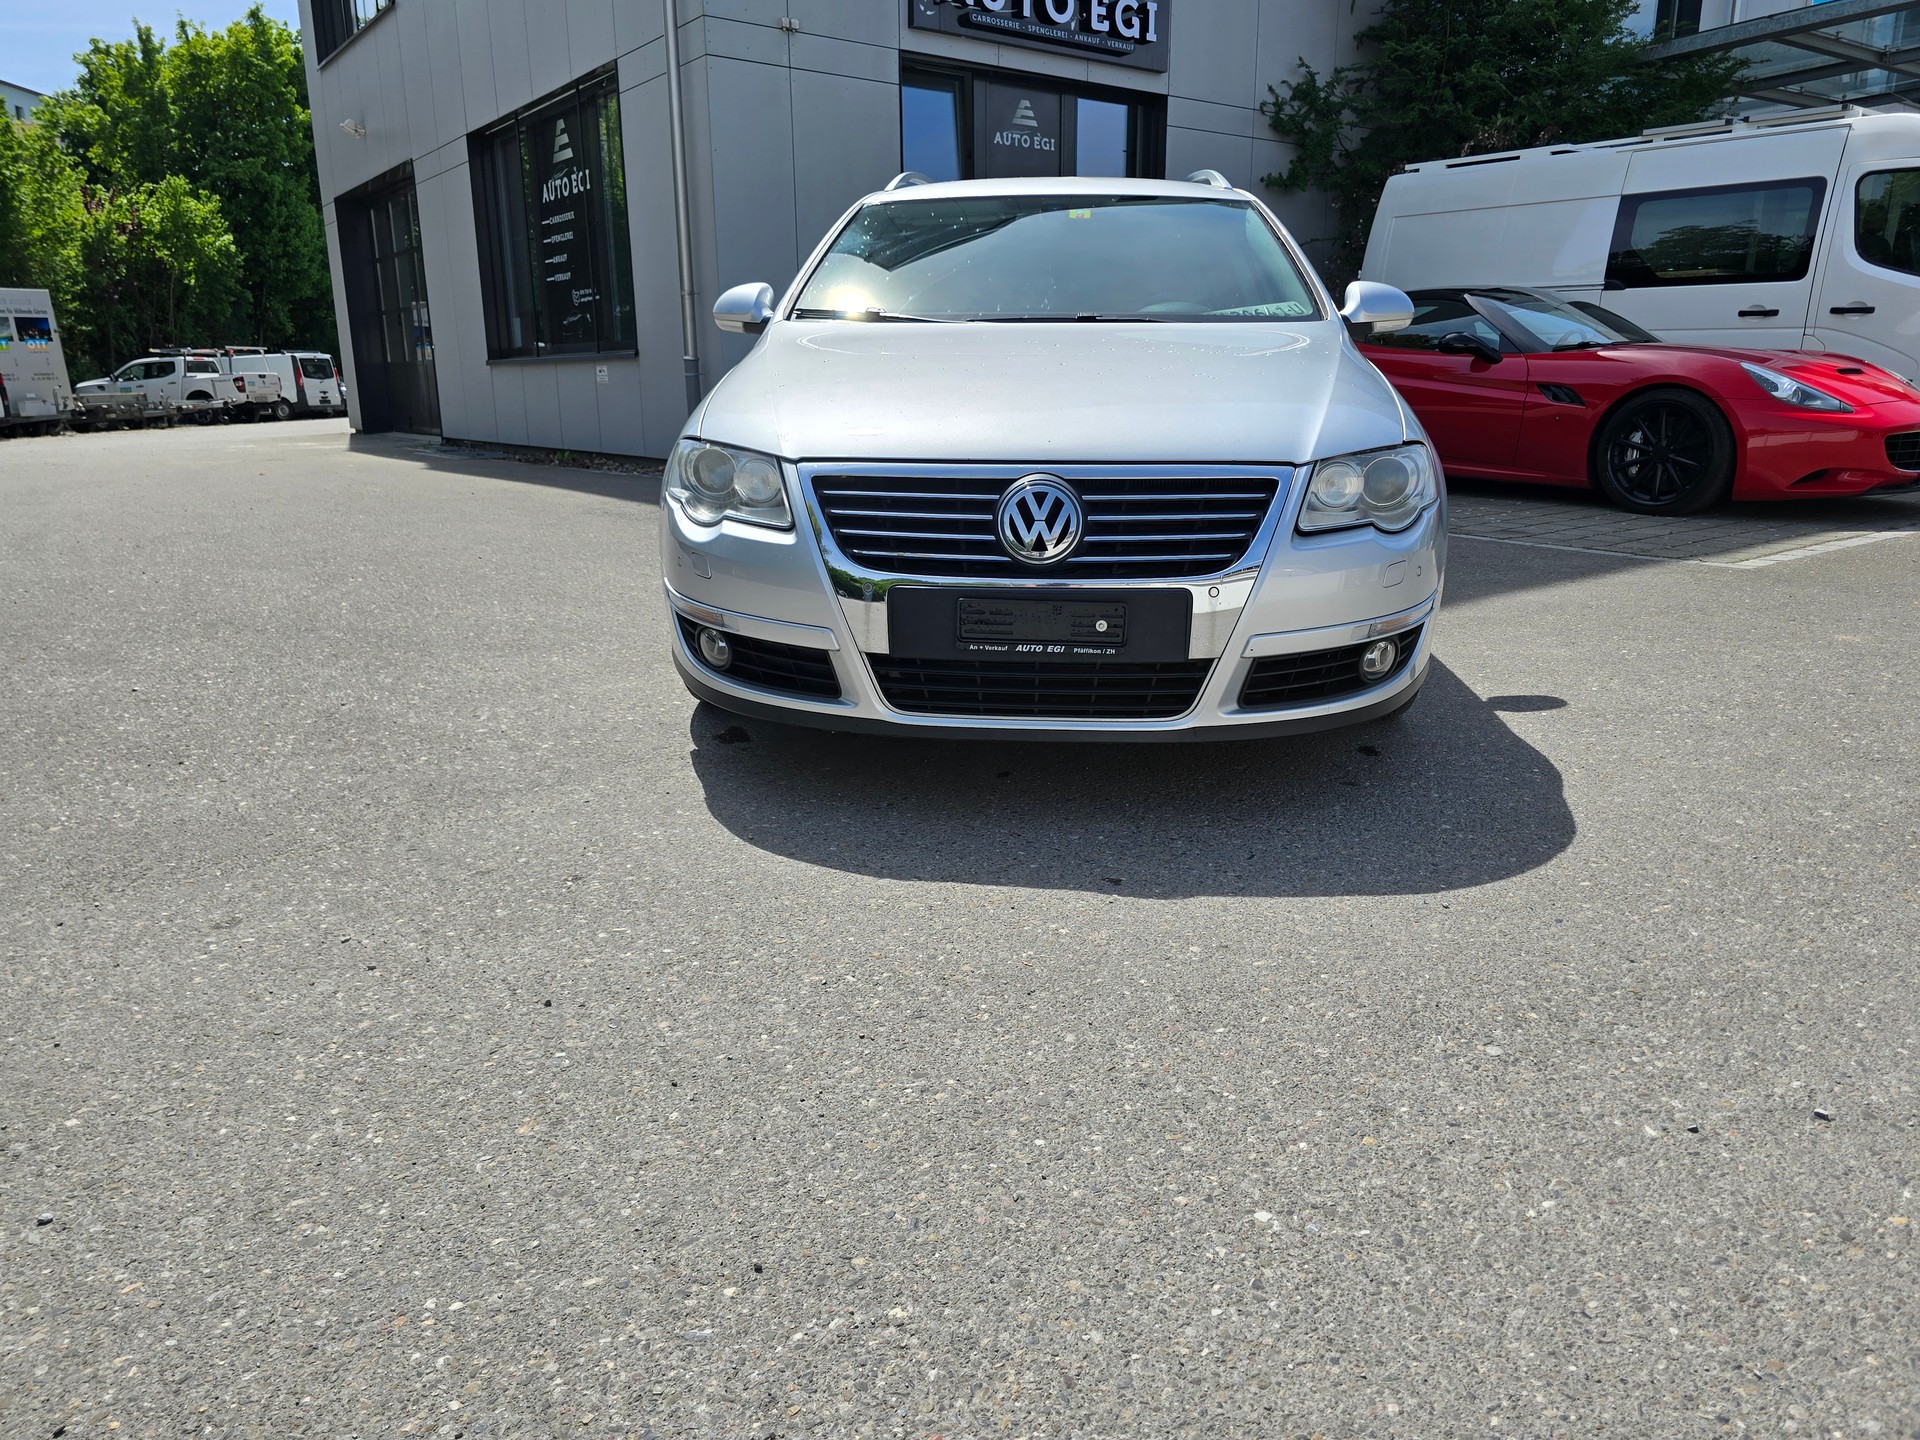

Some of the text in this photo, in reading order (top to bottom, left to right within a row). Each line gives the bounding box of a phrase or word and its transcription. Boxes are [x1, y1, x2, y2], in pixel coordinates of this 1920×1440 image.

[972, 13, 1020, 29] CARROSSERIE
[1028, 24, 1068, 39] SPENGLEREI
[1074, 34, 1100, 45] ANKAUF
[1107, 40, 1135, 50] VERKAUF
[994, 131, 1030, 148] AUTO
[542, 176, 570, 203] AUTO
[1015, 644, 1043, 652] AUTO
[1046, 645, 1065, 653] EGI
